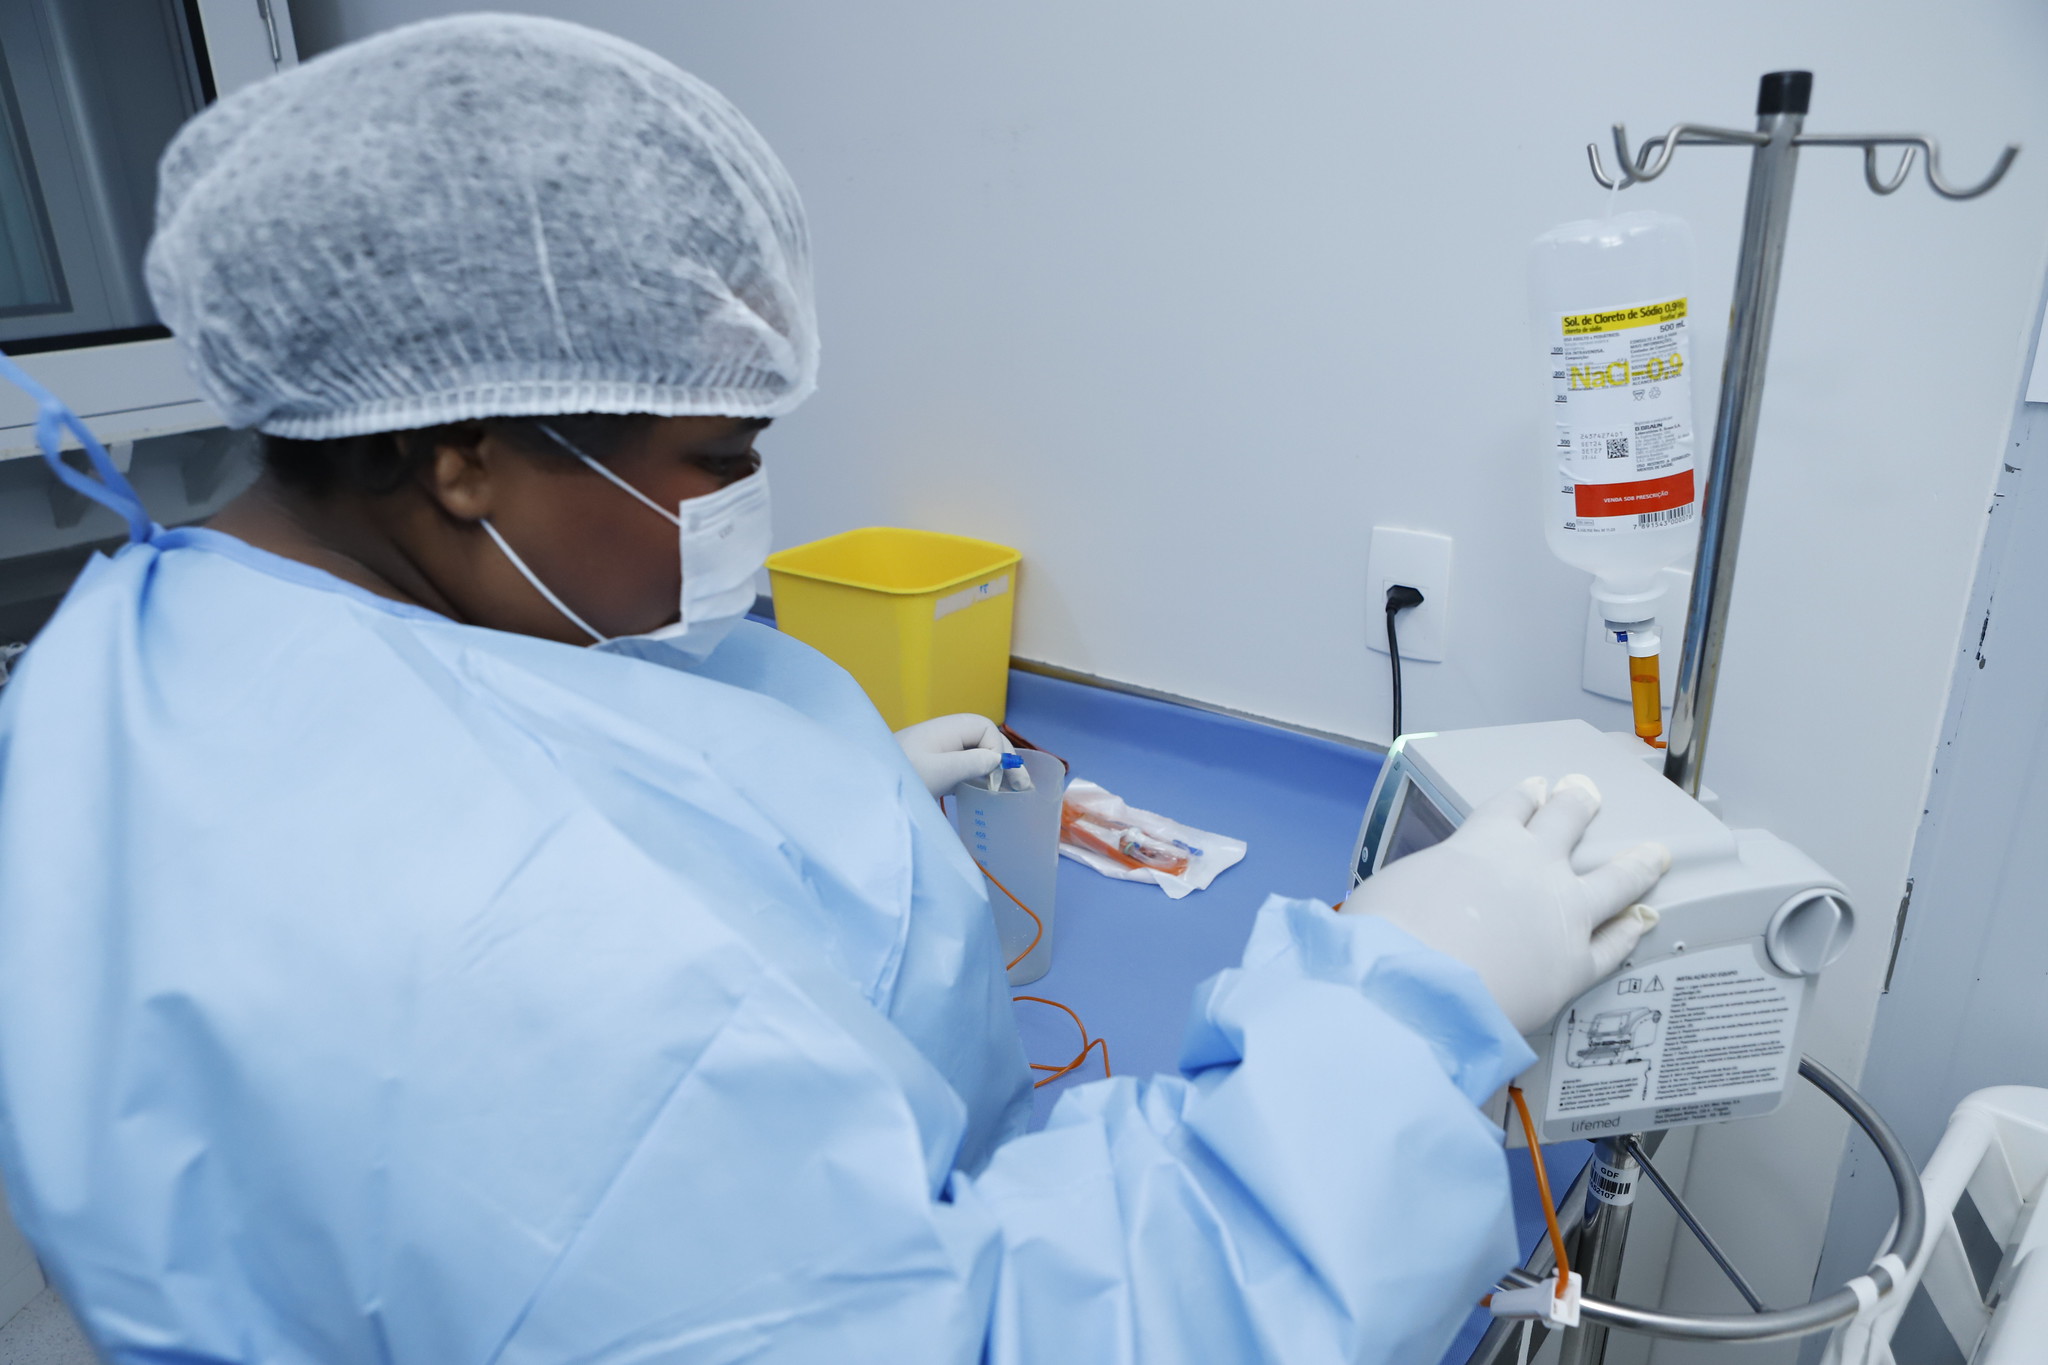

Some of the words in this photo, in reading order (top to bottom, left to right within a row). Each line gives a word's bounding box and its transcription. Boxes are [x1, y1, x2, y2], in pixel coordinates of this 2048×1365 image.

[1564, 317, 1580, 327] Sol.
[1582, 316, 1592, 326] de
[1594, 313, 1626, 324] Cloreto
[1628, 310, 1638, 320] de
[1640, 305, 1663, 318] Sódio
[1660, 323, 1674, 333] 500
[1676, 320, 1686, 328] mL
[1636, 491, 1669, 500] PRESCRIÇÃO
[1571, 1116, 1621, 1133] lifemed
[1600, 1167, 1620, 1179] GDF
